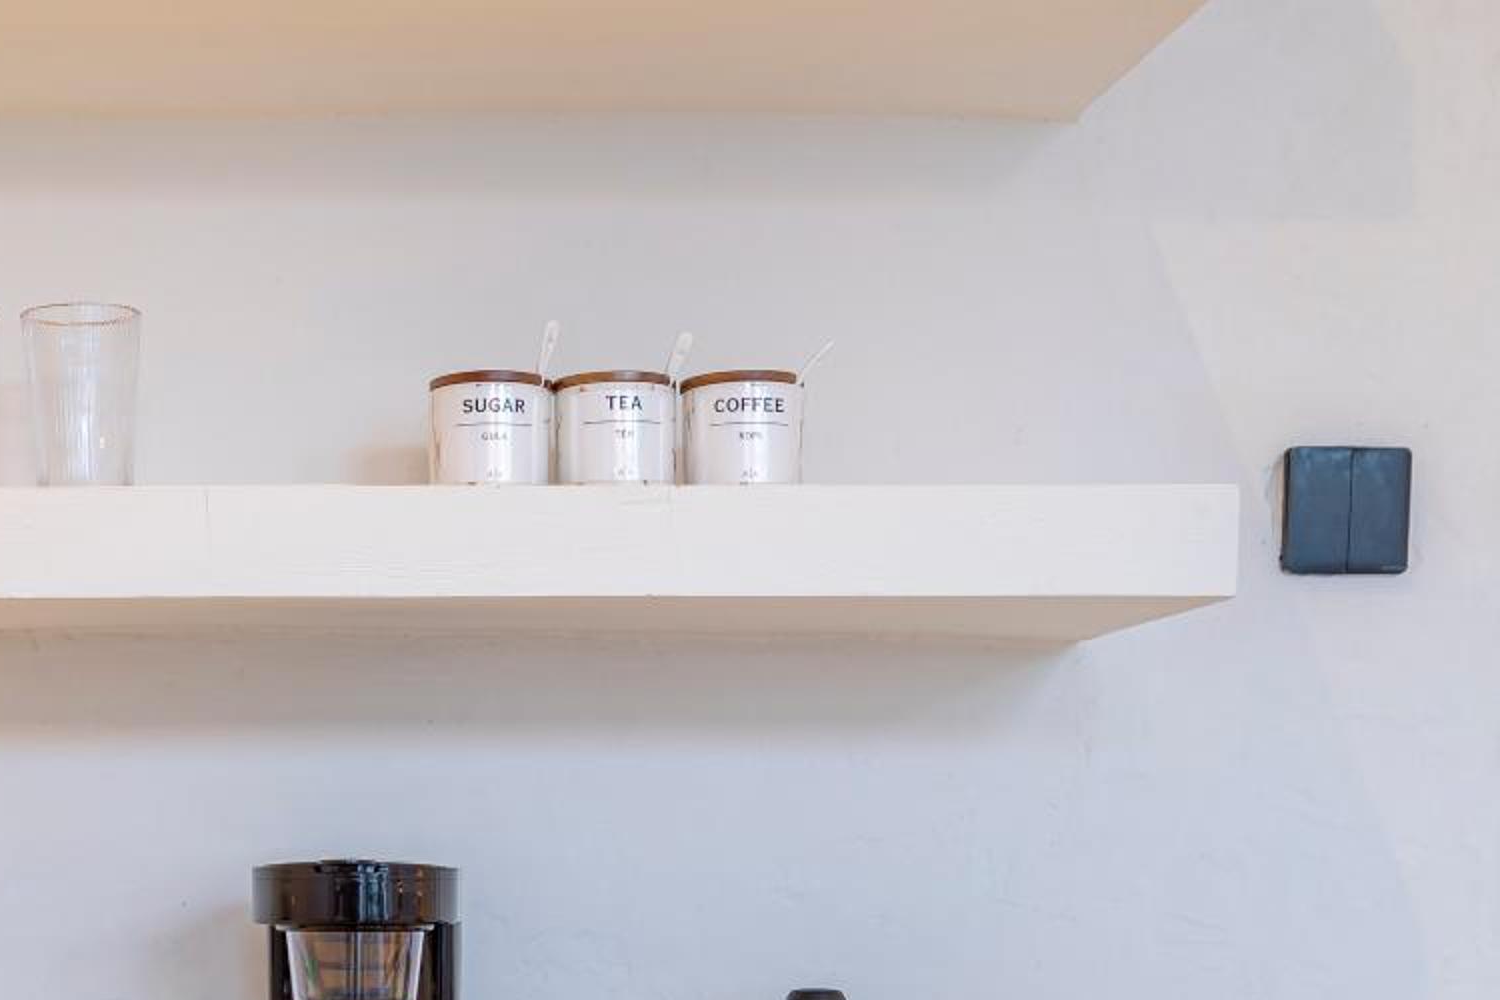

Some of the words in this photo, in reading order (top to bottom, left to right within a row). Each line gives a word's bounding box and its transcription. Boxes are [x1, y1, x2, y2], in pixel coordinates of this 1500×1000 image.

[463, 397, 525, 413] SUGAR
[605, 395, 642, 410] TEA
[714, 397, 785, 413] COFFEE
